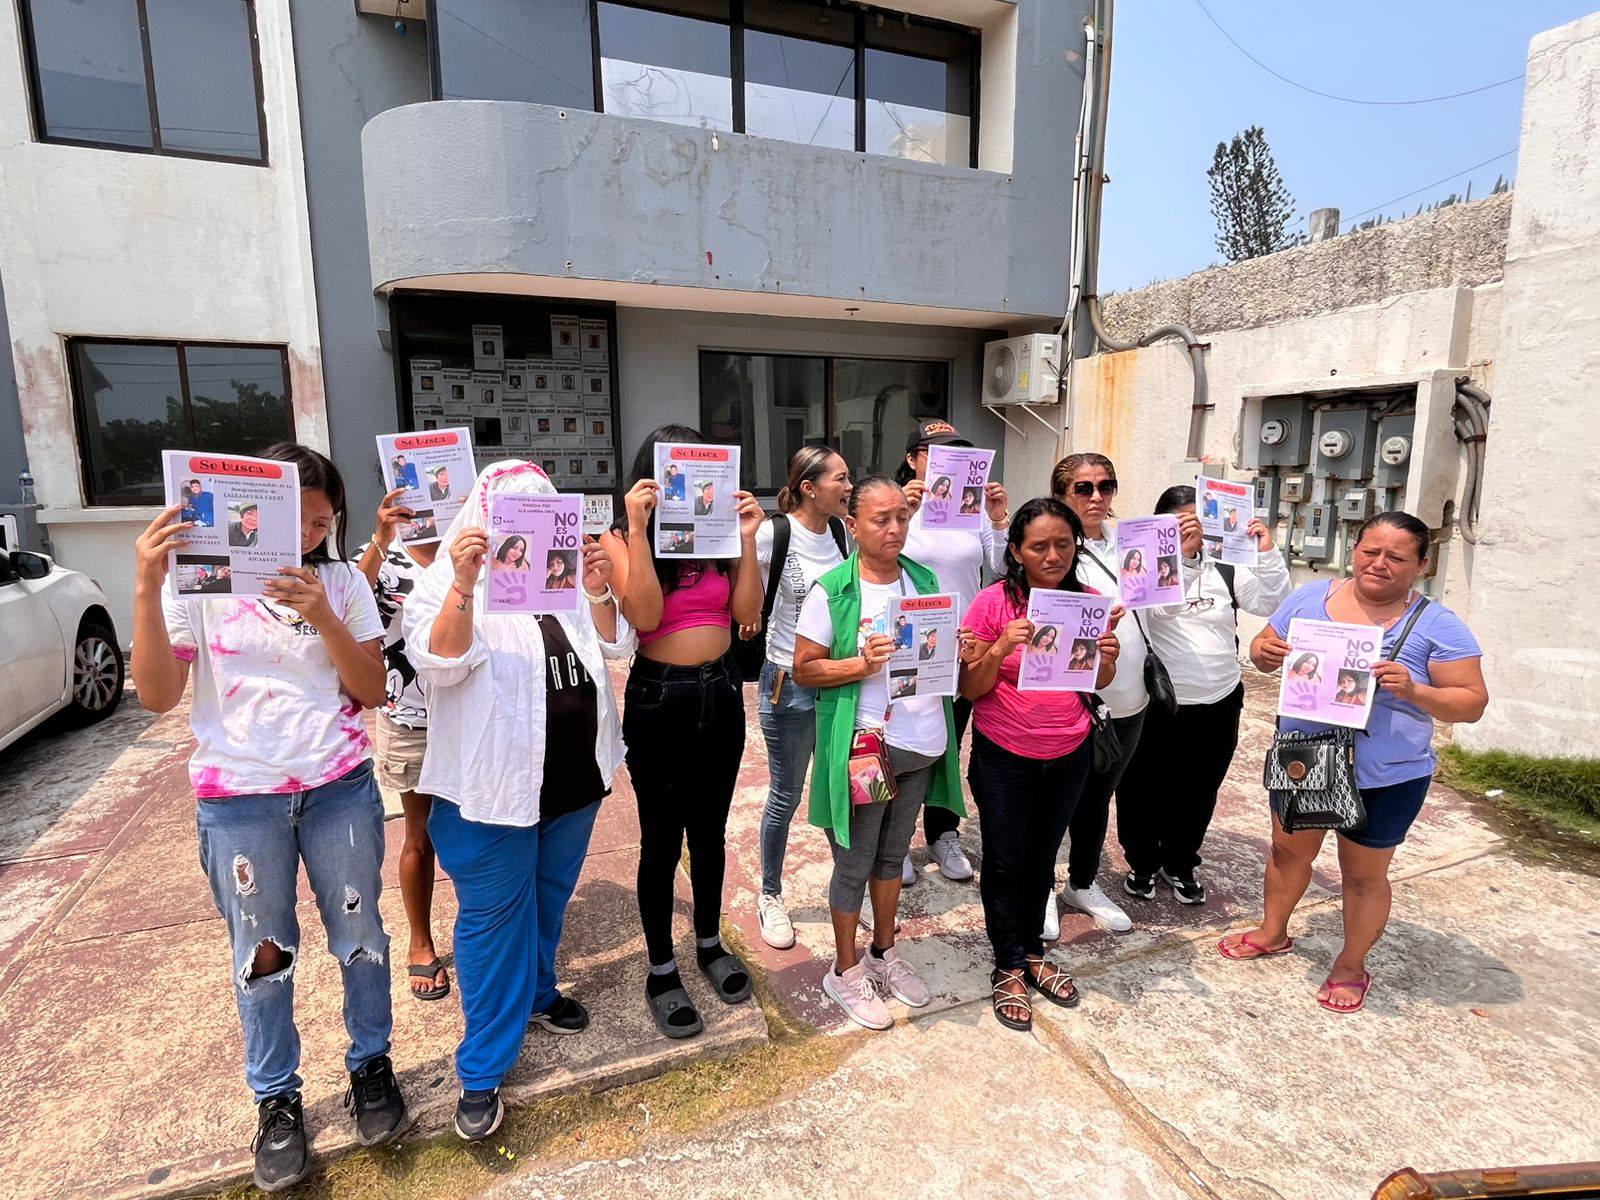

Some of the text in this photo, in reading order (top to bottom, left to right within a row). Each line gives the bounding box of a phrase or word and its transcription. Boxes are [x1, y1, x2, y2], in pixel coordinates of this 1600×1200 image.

[199, 460, 264, 474] Se busca
[969, 461, 988, 471] NO
[967, 476, 983, 485] NO
[554, 512, 578, 527] NO
[555, 526, 567, 535] ES
[1157, 527, 1176, 539] NO
[552, 535, 577, 548] NO
[1158, 544, 1175, 555] NO
[1081, 607, 1105, 619] NO
[1078, 626, 1100, 638] NO
[1347, 639, 1374, 652] NO
[1343, 657, 1369, 669] NO
